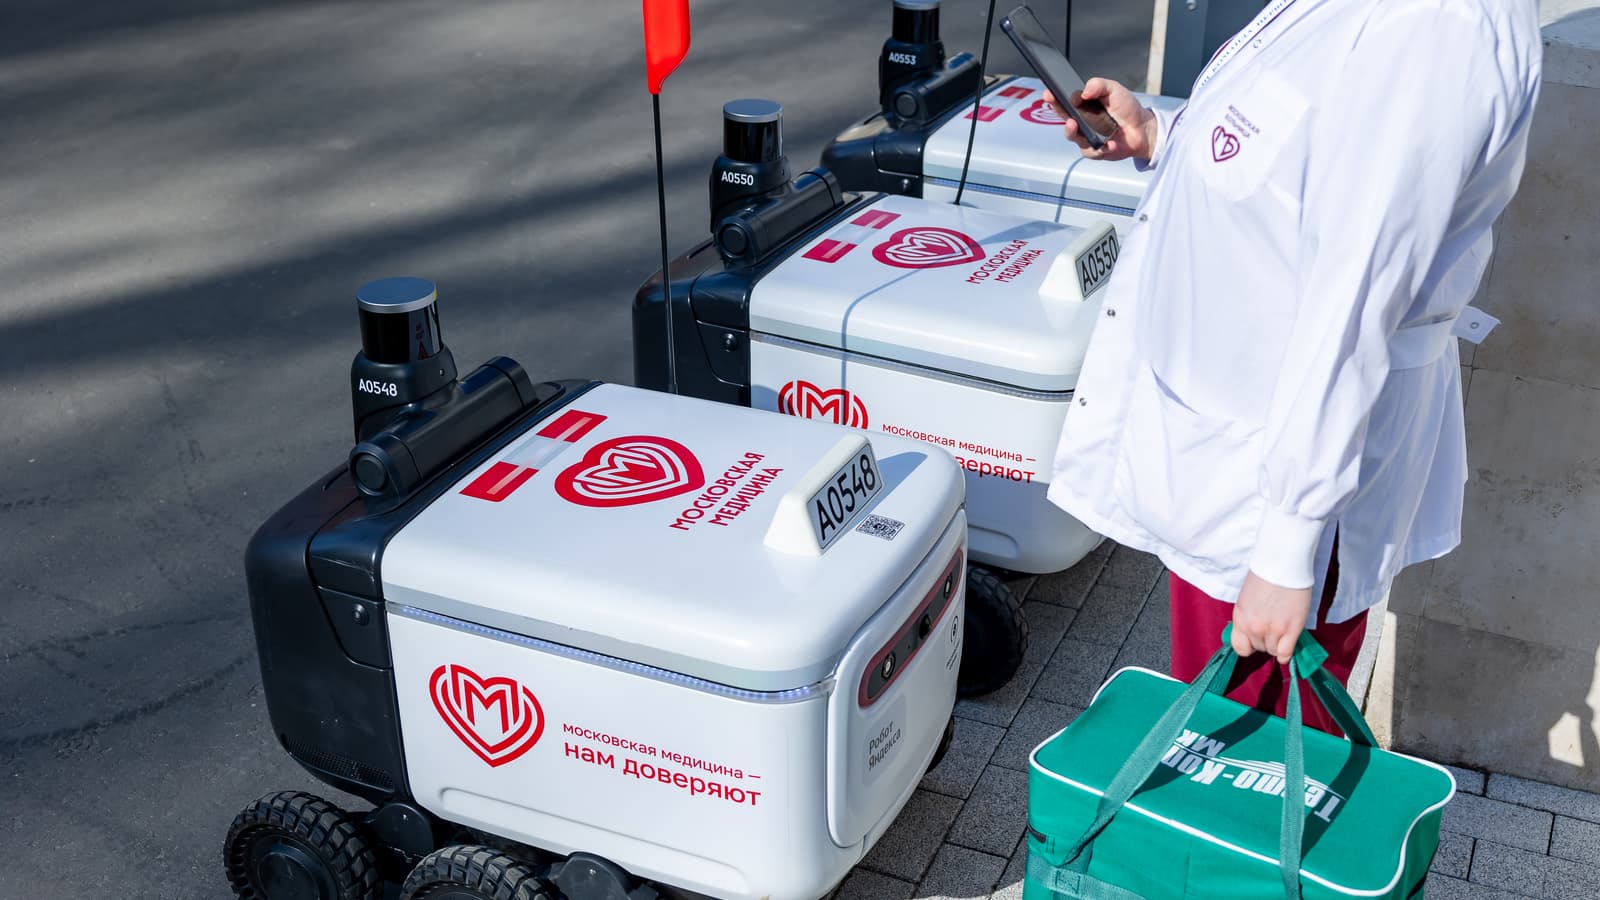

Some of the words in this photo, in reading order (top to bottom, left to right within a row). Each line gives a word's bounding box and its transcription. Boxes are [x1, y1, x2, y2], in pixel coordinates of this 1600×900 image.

[888, 52, 917, 65] A0553
[721, 170, 754, 186] A0550
[965, 239, 1030, 285] МОСКОВСКАЯ
[994, 248, 1046, 283] МЕДИЦИНА
[1081, 235, 1118, 292] A0550
[359, 378, 398, 397] A0548
[882, 424, 956, 447] московская
[958, 441, 1023, 463] медицина
[669, 452, 765, 531] МОСКОВСКАЯ
[708, 466, 784, 527] МЕДИЦИНА
[816, 453, 876, 541] A0548
[563, 722, 657, 757] московская
[661, 750, 744, 780] медицина
[868, 720, 894, 755] Робот
[868, 728, 902, 771] Яндекса
[564, 742, 615, 769] нам
[623, 758, 762, 807] доверяют
